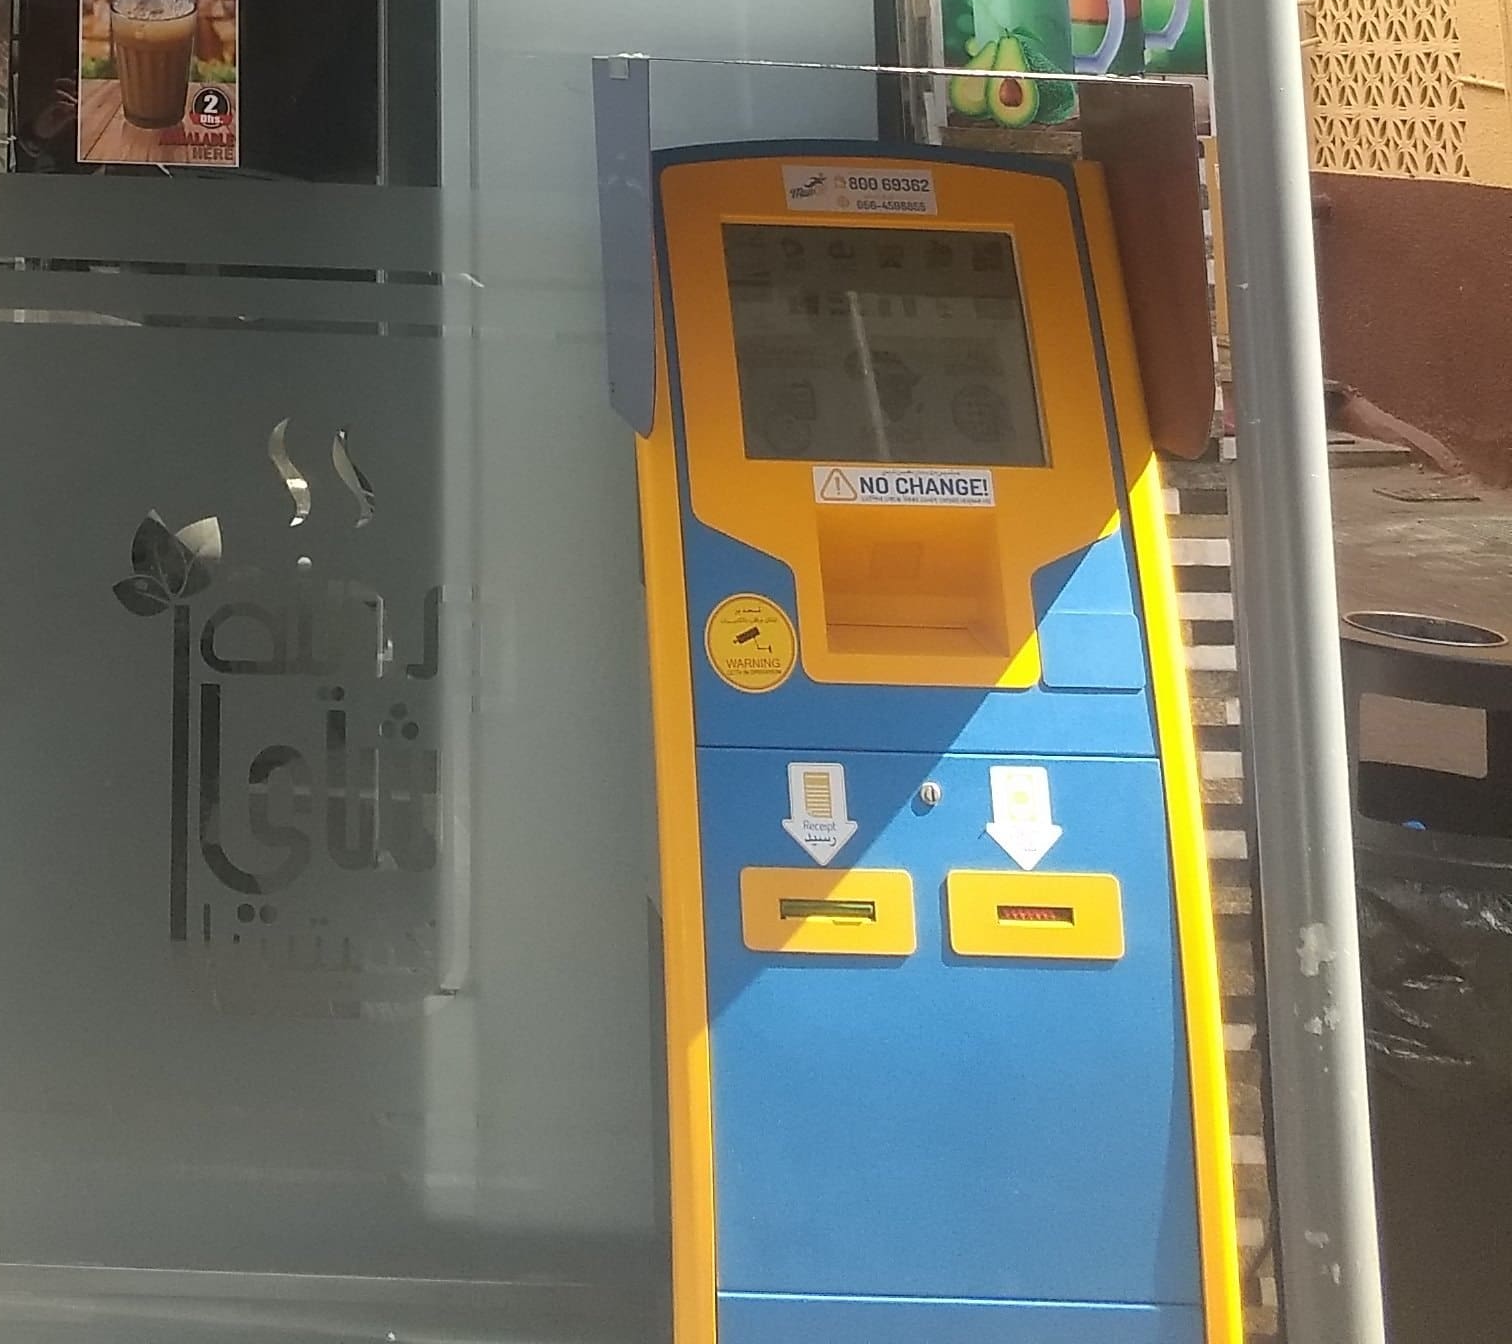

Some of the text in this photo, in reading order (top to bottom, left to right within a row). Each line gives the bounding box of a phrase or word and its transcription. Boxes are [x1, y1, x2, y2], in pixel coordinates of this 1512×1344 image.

[203, 94, 219, 114] 2
[848, 176, 930, 192] 800 69362
[859, 476, 989, 496] NO CHANGE!
[726, 657, 781, 669] WARNING
